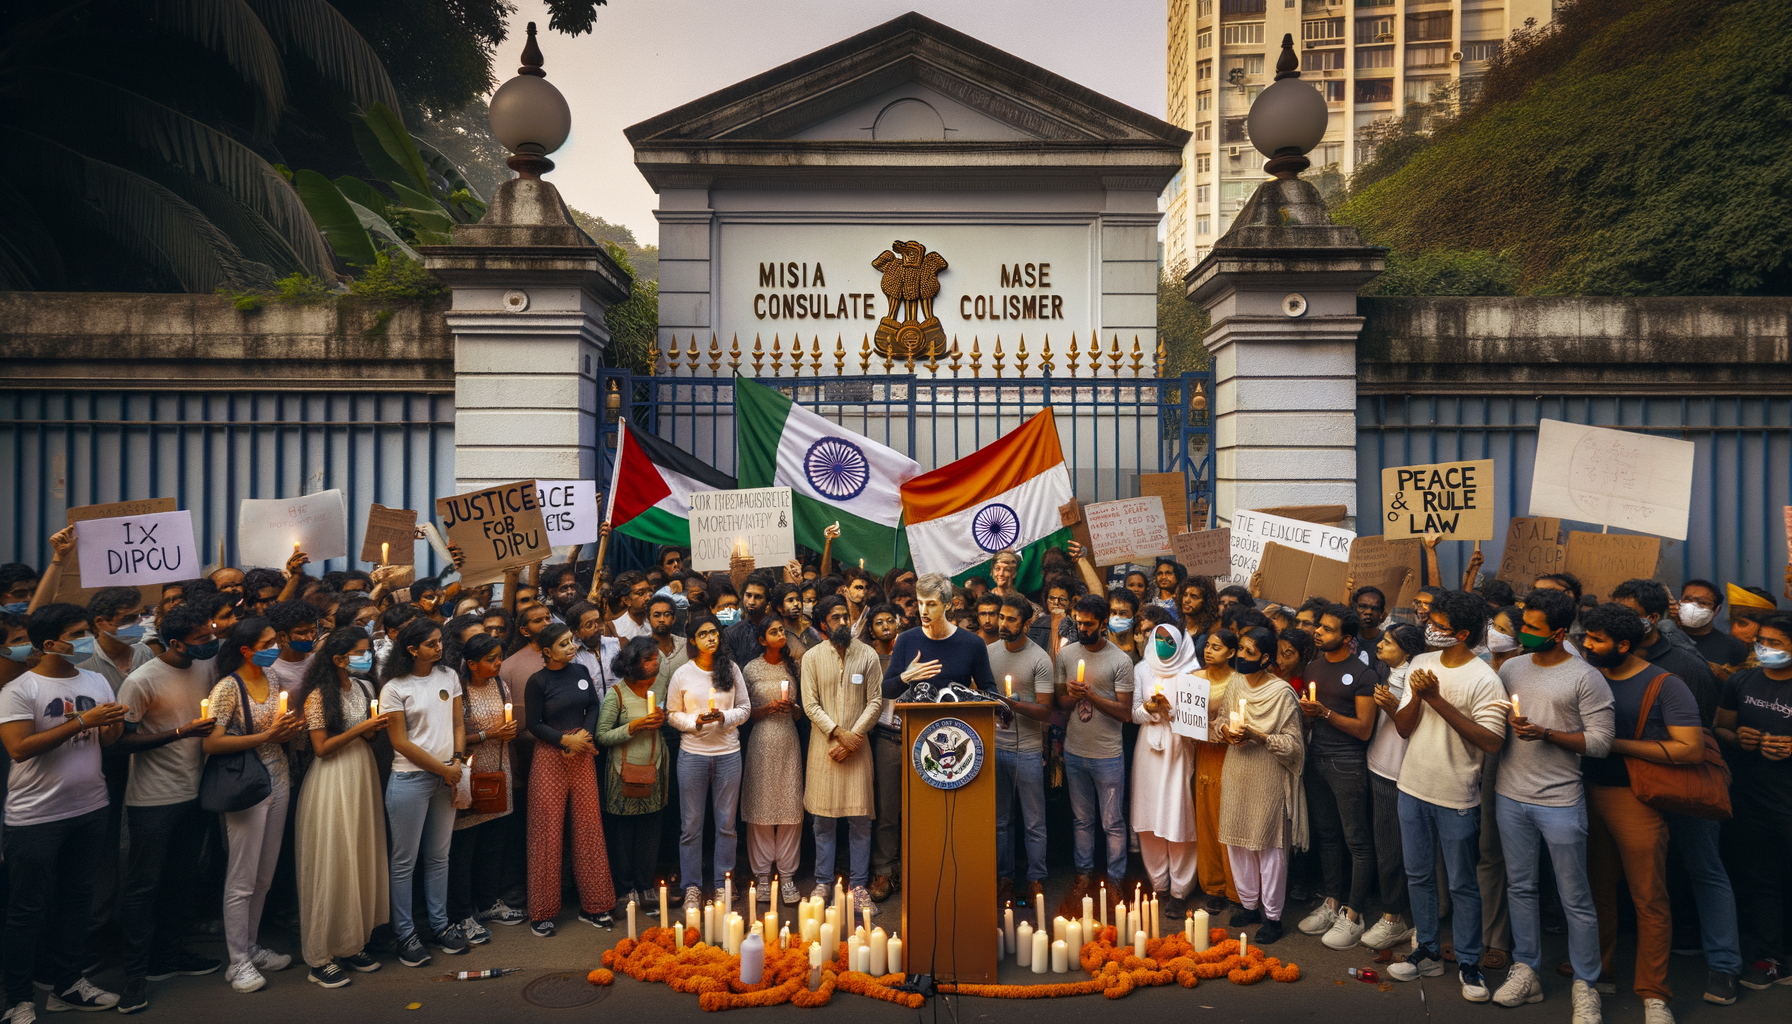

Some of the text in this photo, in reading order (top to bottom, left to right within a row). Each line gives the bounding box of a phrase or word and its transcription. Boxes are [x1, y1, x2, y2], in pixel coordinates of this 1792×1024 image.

[759, 262, 826, 289] MISIA
[754, 293, 876, 320] CONSULATE
[960, 294, 1064, 321] COLISMER
[1397, 466, 1477, 491] PEACE
[443, 483, 537, 530] JUSTICE
[1422, 489, 1477, 513] RULE
[1409, 512, 1460, 534] LAW
[492, 528, 539, 561] DIPU
[107, 545, 181, 575] DIPCU
